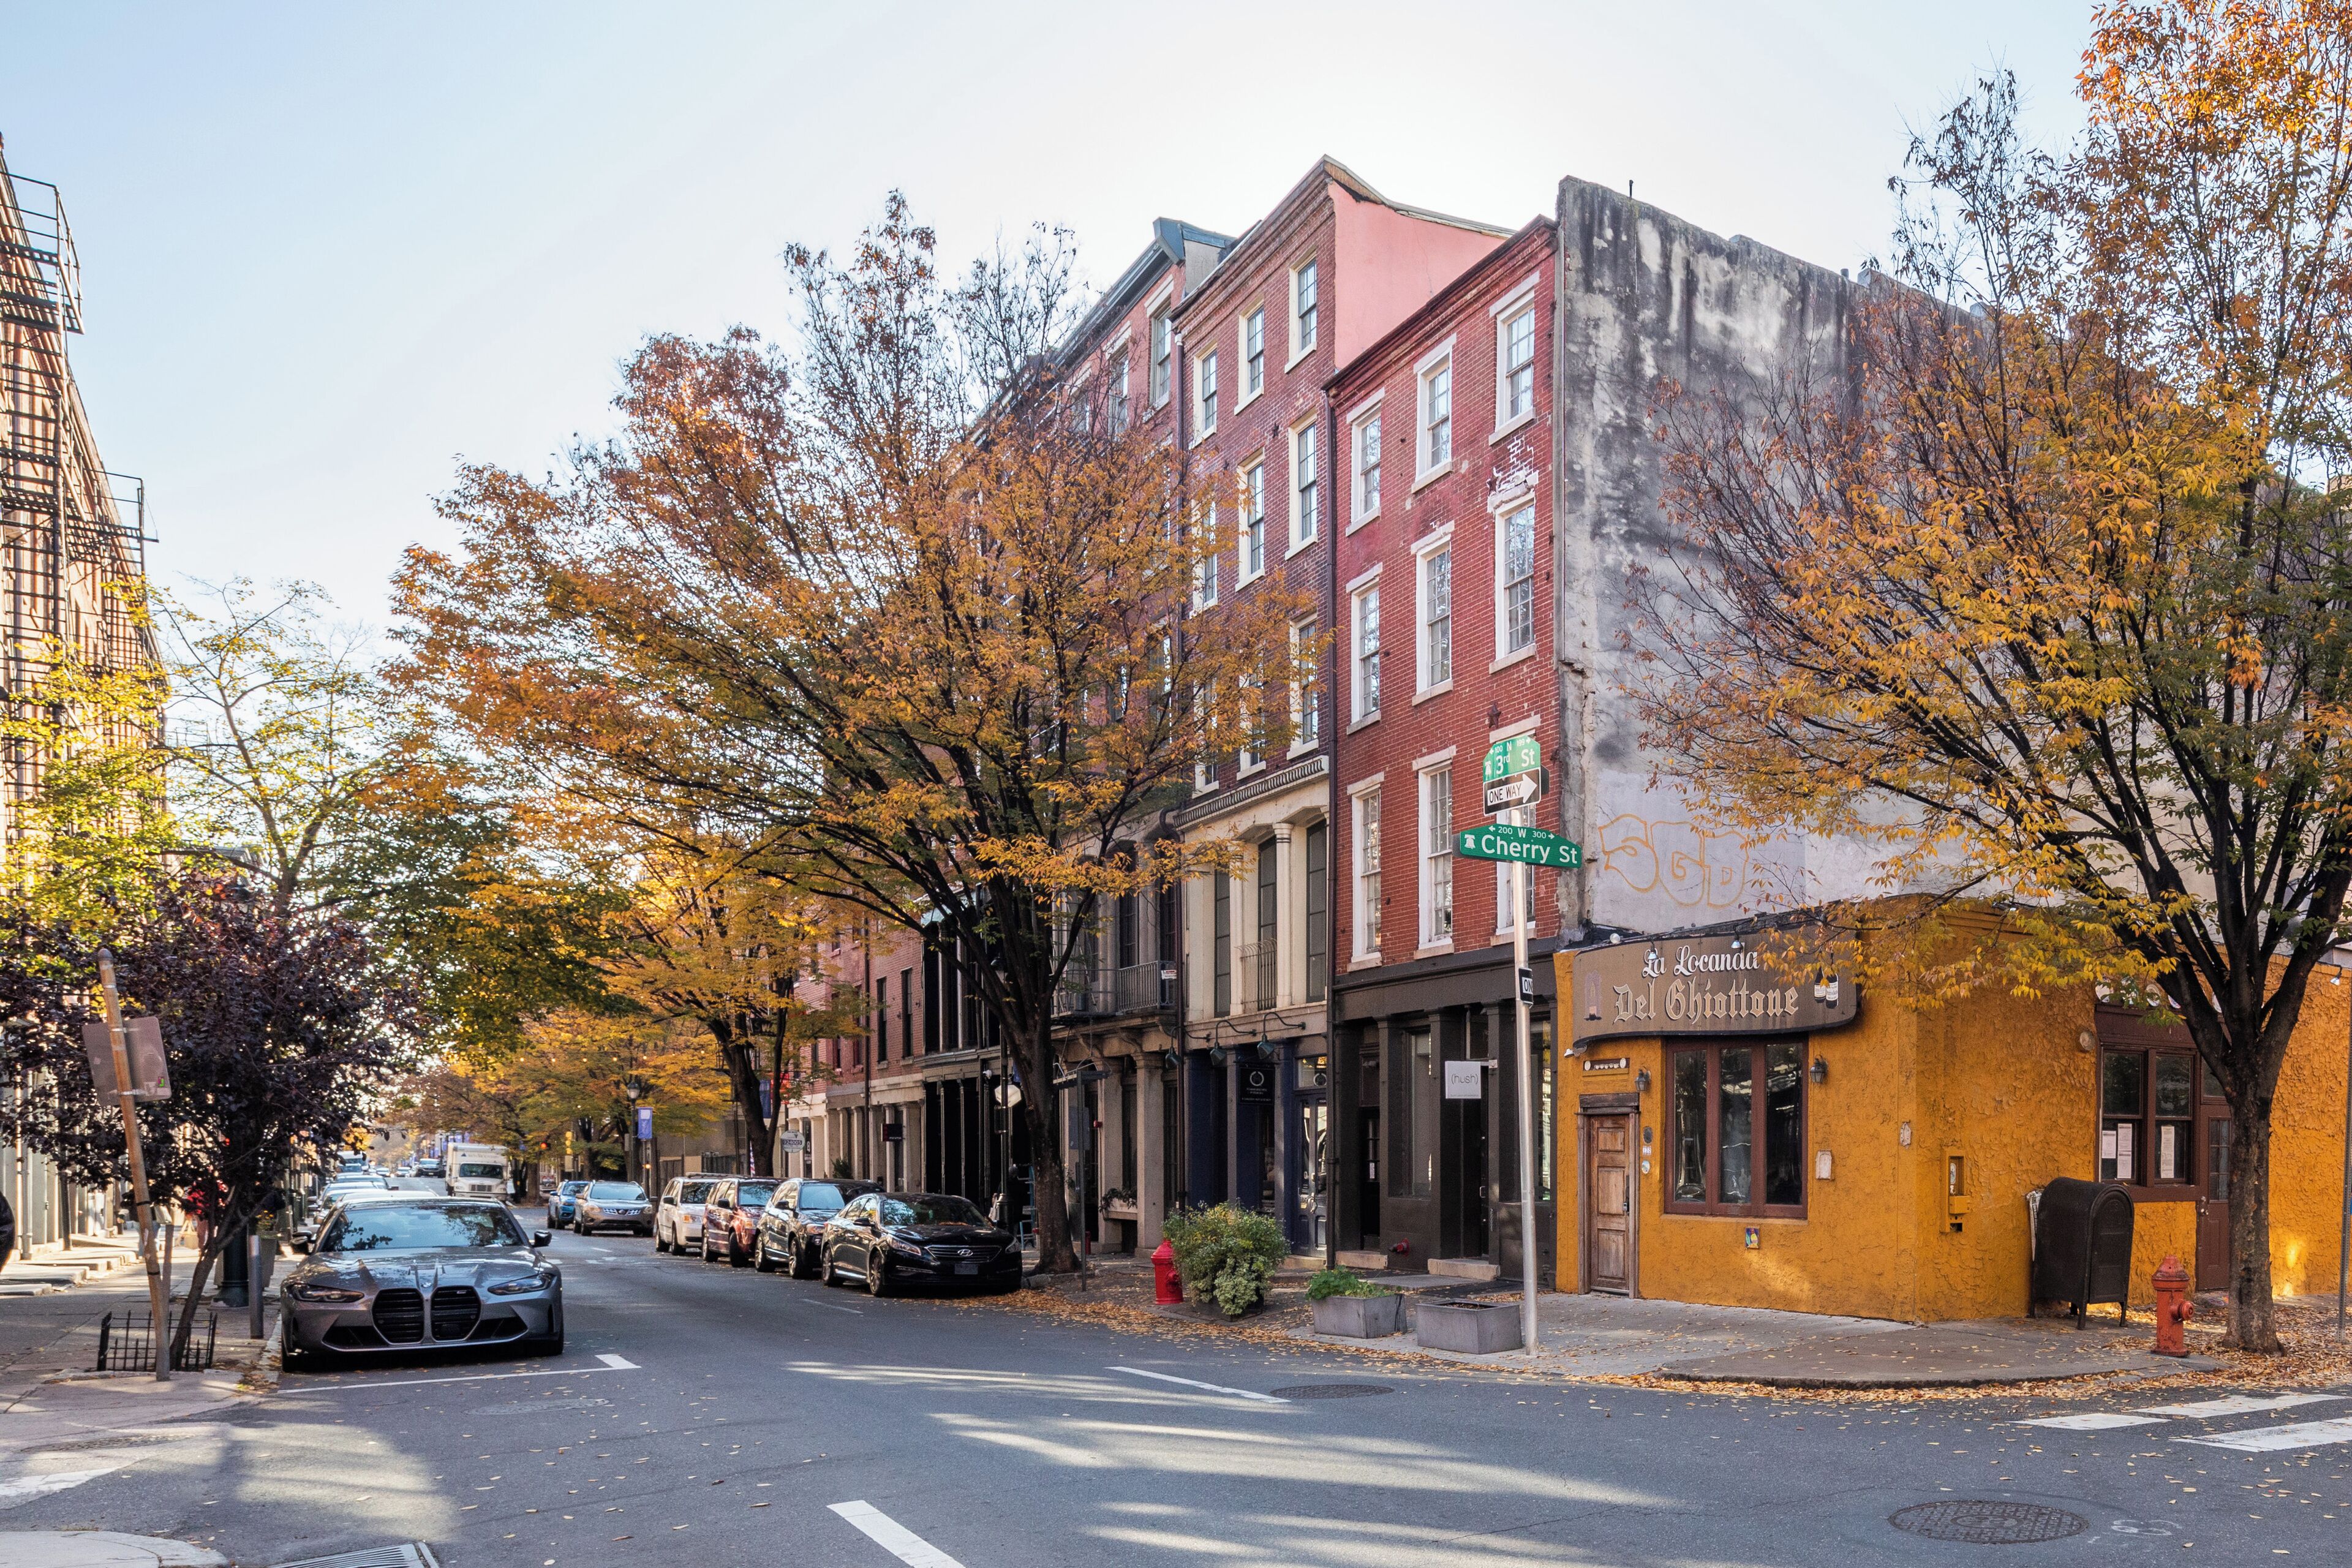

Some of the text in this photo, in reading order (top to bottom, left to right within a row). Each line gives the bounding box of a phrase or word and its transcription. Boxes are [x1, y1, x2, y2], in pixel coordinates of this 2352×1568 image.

[1494, 745, 1503, 753] 100
[1506, 741, 1512, 751] N
[1496, 748, 1535, 774] 3rd St
[1489, 783, 1522, 804] ONE WAY
[1498, 826, 1547, 839] 200 W 300
[1481, 834, 1578, 864] Cherry St
[1642, 942, 1760, 978] La Locanda
[1612, 976, 1800, 1025] Del Ghiottone
